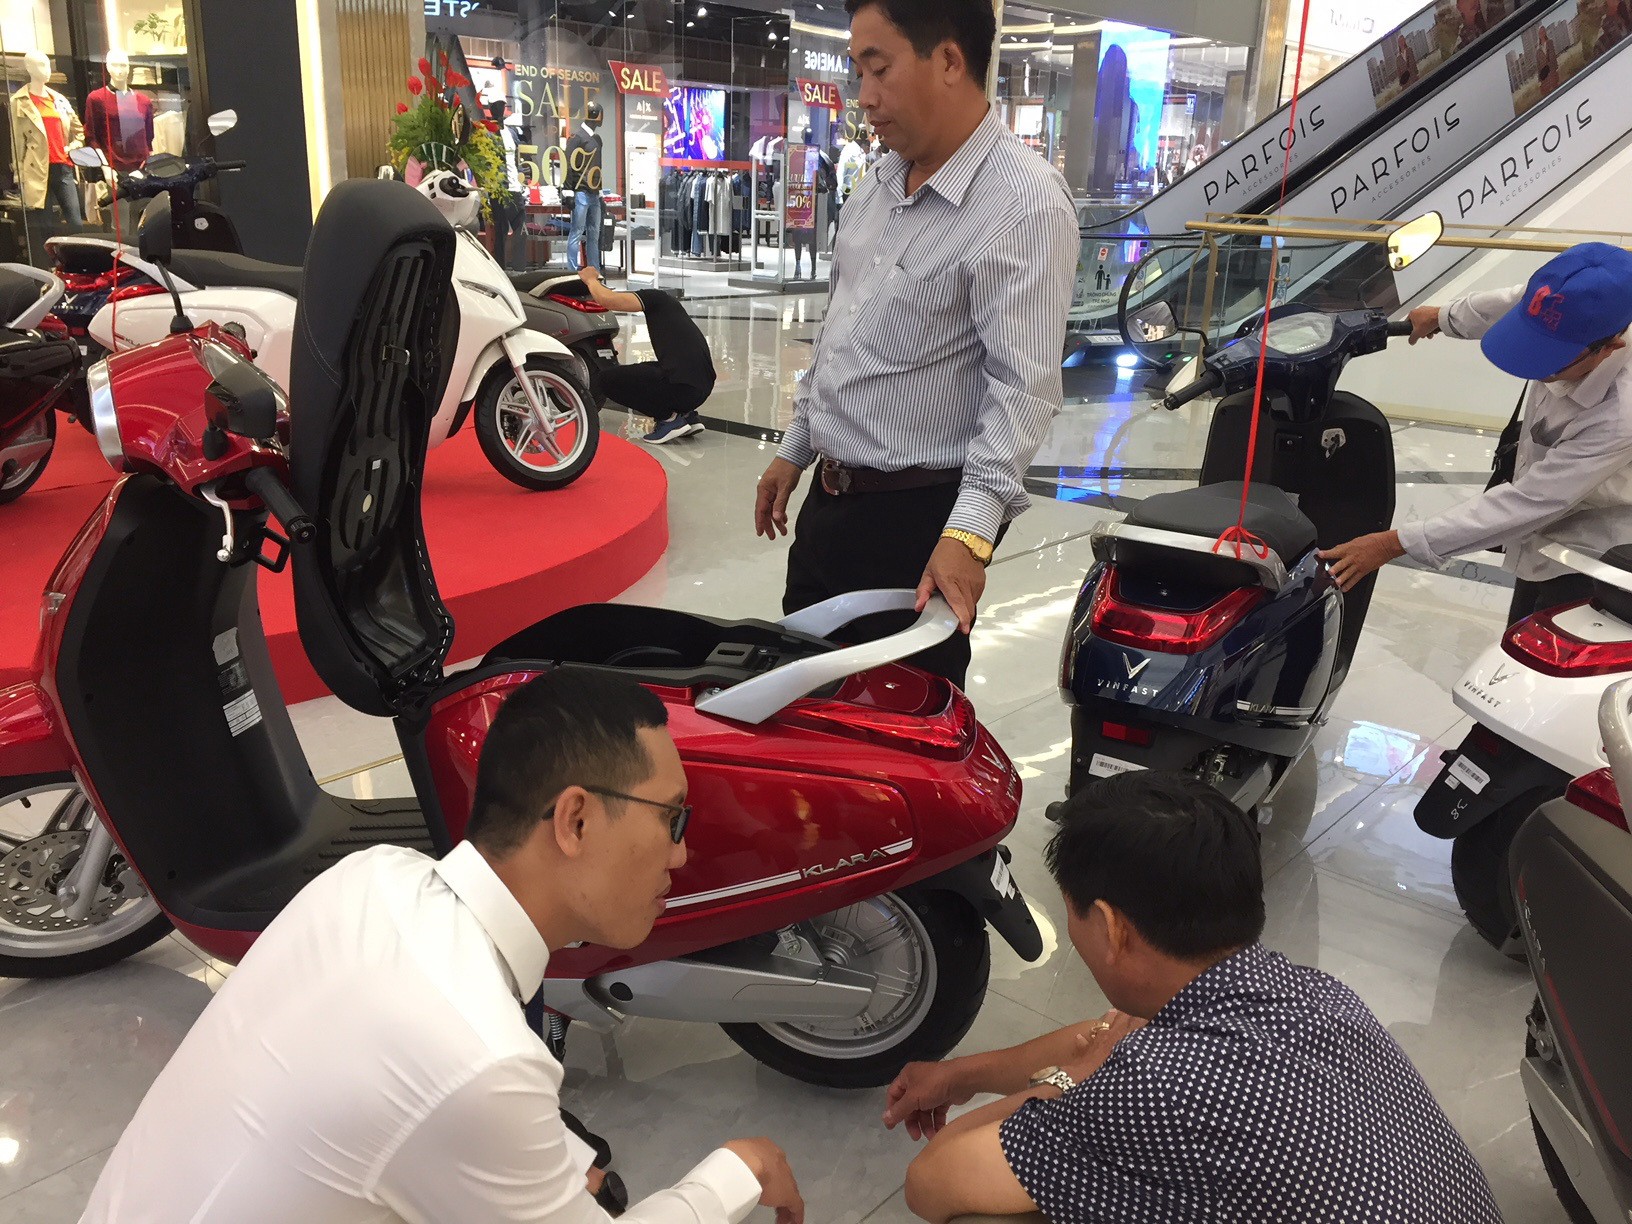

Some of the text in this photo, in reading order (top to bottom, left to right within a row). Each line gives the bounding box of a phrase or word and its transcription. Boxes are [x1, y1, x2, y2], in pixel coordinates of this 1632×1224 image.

[514, 64, 600, 84] END OF SEASON
[620, 67, 662, 93] SALE
[804, 82, 836, 105] SALE
[513, 79, 601, 121] SALE
[517, 144, 602, 190] 50%
[1203, 105, 1325, 206] PARFOIS
[1242, 152, 1298, 196] ACCESSORES
[1331, 102, 1460, 214] PARFOIS
[1457, 98, 1593, 219] PARFOIS
[1371, 155, 1432, 203] ACCESSORIES
[1500, 155, 1562, 207] ACCESSORIES
[1097, 678, 1159, 698] VINFAST
[1463, 680, 1501, 708] VINFAST
[802, 848, 887, 878] KLARA
